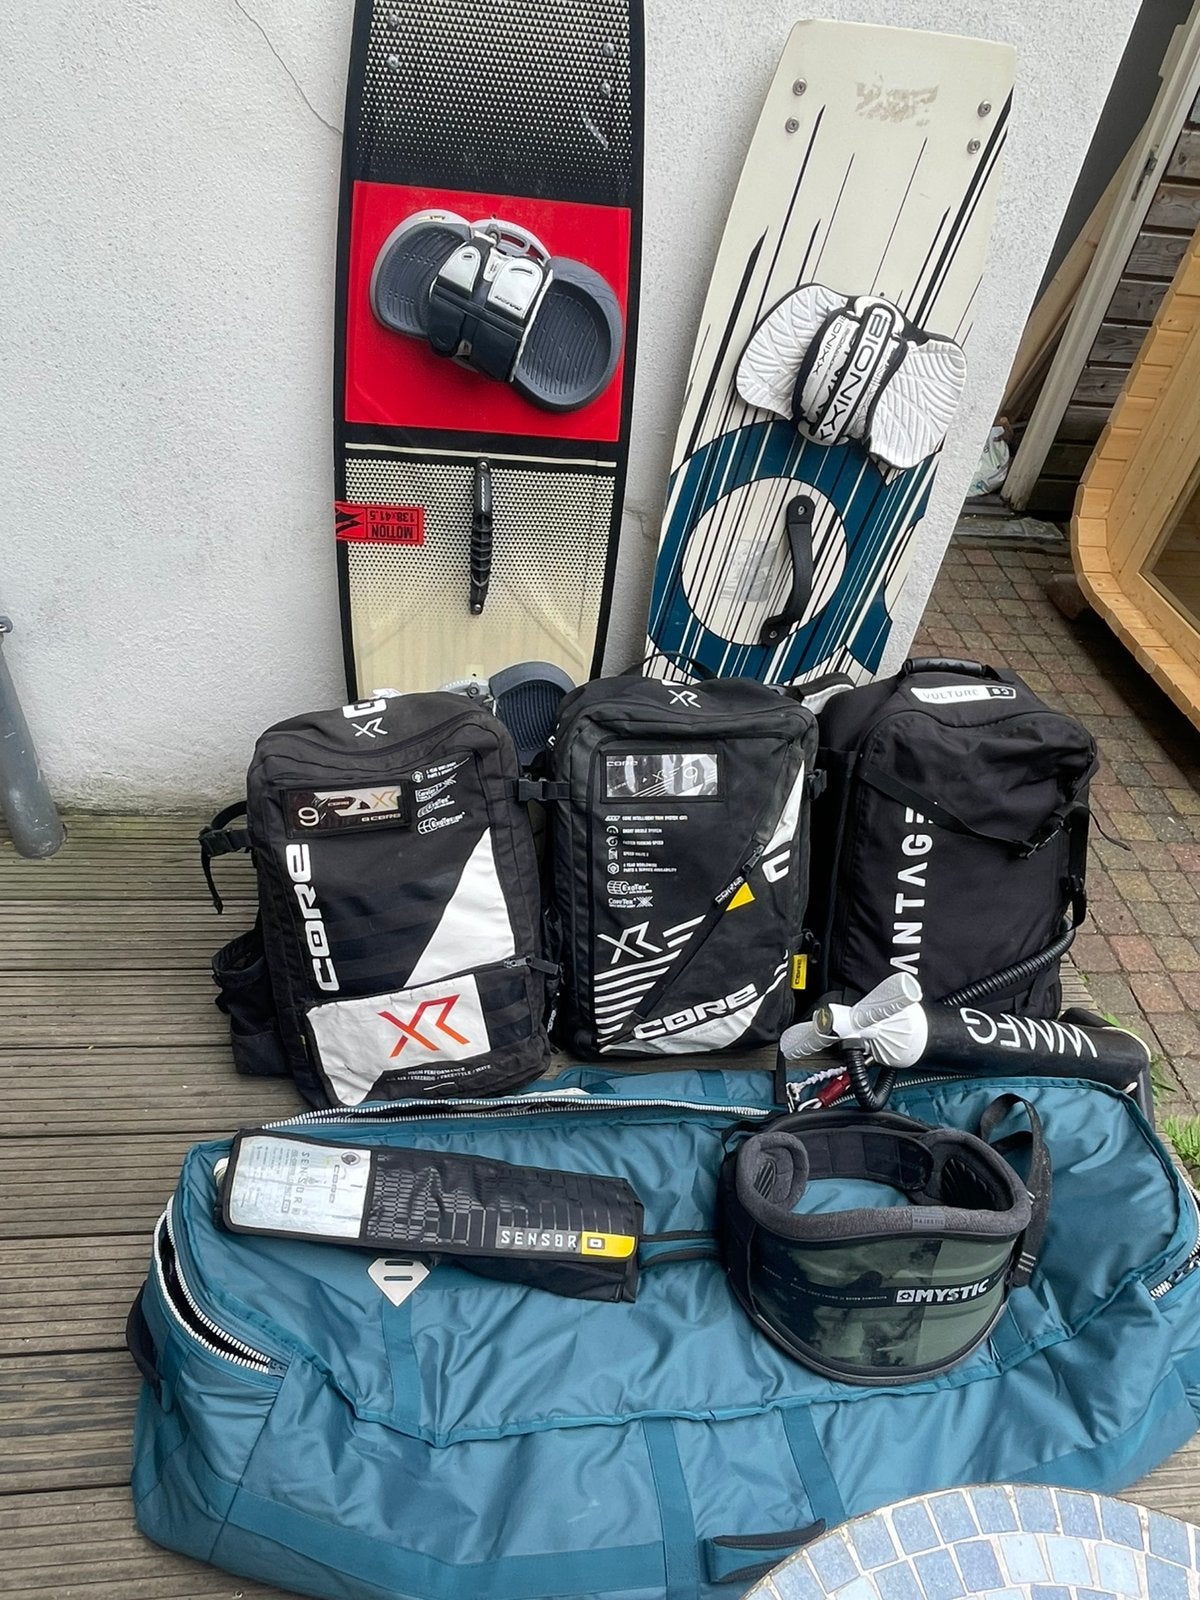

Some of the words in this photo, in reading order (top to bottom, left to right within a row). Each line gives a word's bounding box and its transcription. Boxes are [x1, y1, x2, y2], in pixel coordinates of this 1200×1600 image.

[369, 510, 415, 522] 138x41.5
[371, 524, 414, 539] MOTION
[667, 690, 702, 708] XR
[922, 688, 980, 700] VULTURE
[351, 716, 389, 738] XR
[298, 806, 320, 827] 9
[889, 806, 933, 976] ANTAG
[284, 843, 340, 992] CORE
[597, 920, 663, 965] XR
[633, 983, 759, 1041] CORE
[376, 993, 471, 1059] XR
[959, 1007, 1099, 1058] WMFG
[500, 1230, 577, 1249] SENSOR
[916, 1278, 989, 1304] MYSTIC
